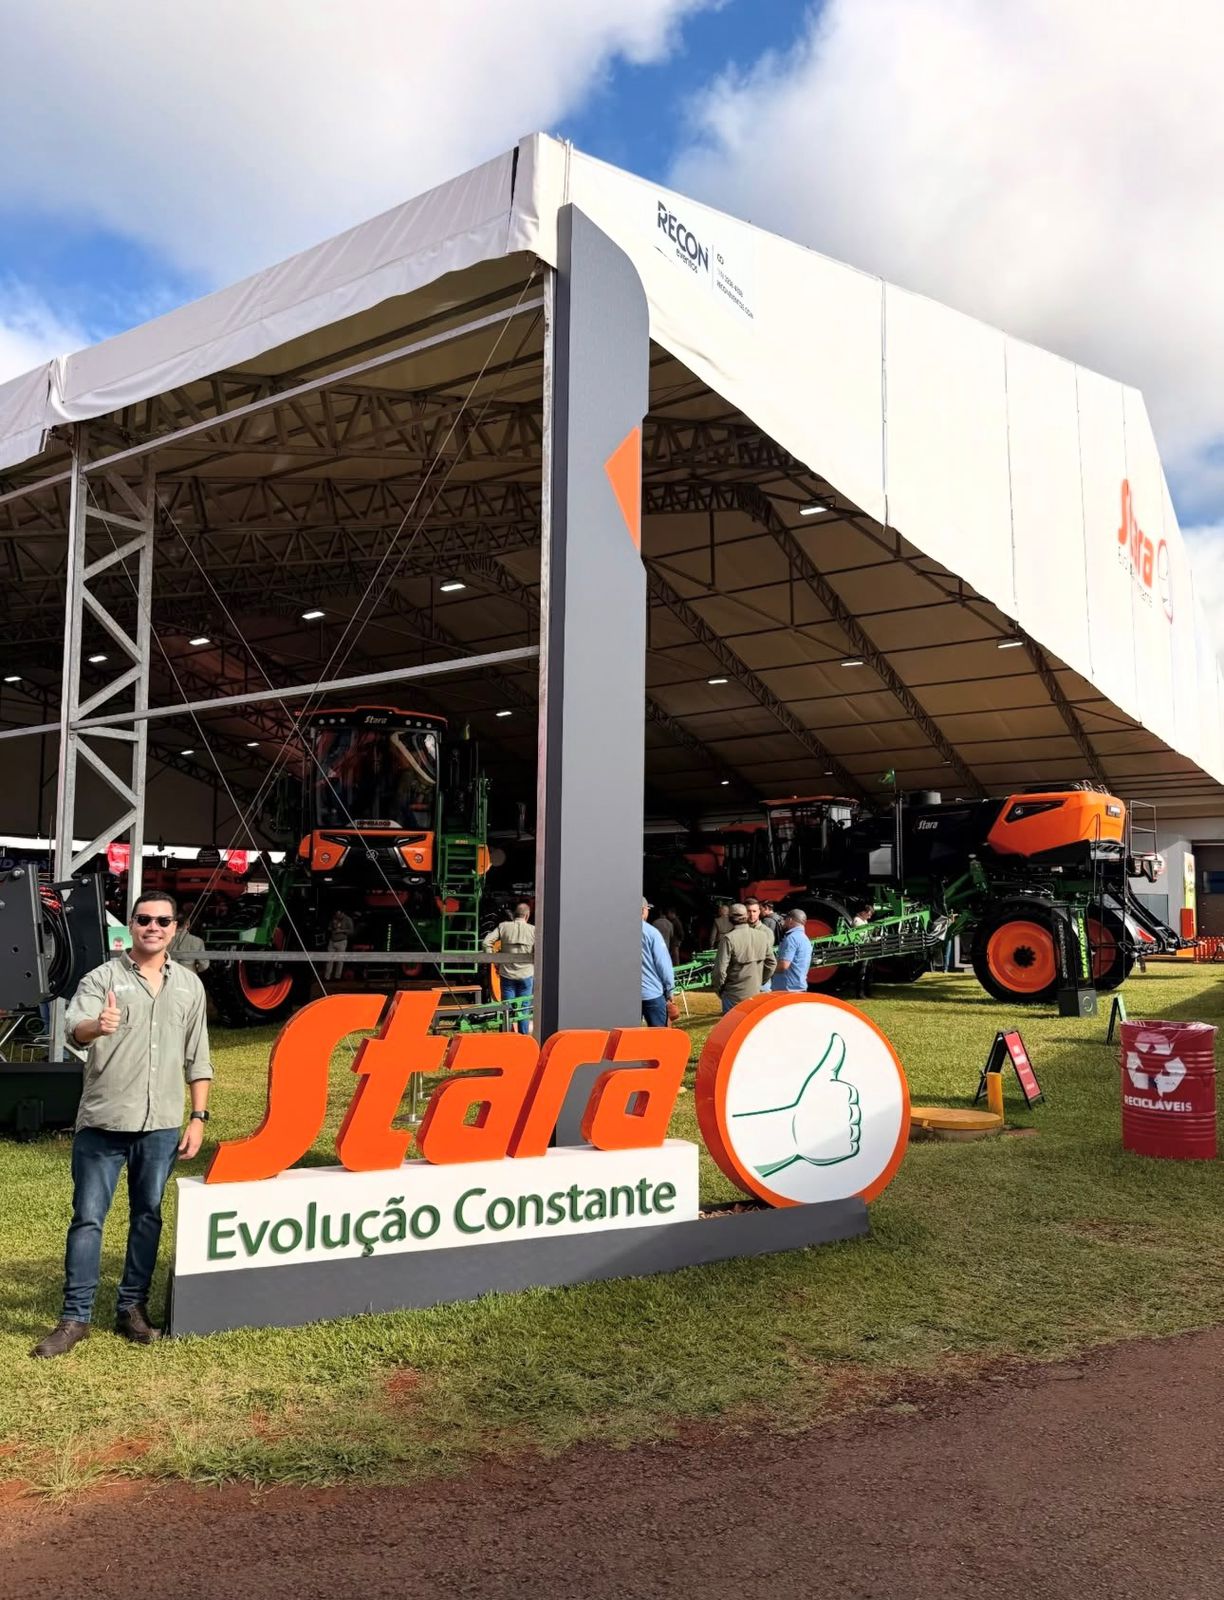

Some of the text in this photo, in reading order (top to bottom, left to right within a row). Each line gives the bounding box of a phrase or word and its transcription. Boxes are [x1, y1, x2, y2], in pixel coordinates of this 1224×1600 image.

[657, 200, 709, 273] RECON
[364, 715, 388, 725] Stara
[917, 820, 939, 830] Stara
[204, 990, 691, 1184] Stara
[208, 1177, 677, 1260] Evolução Constante
